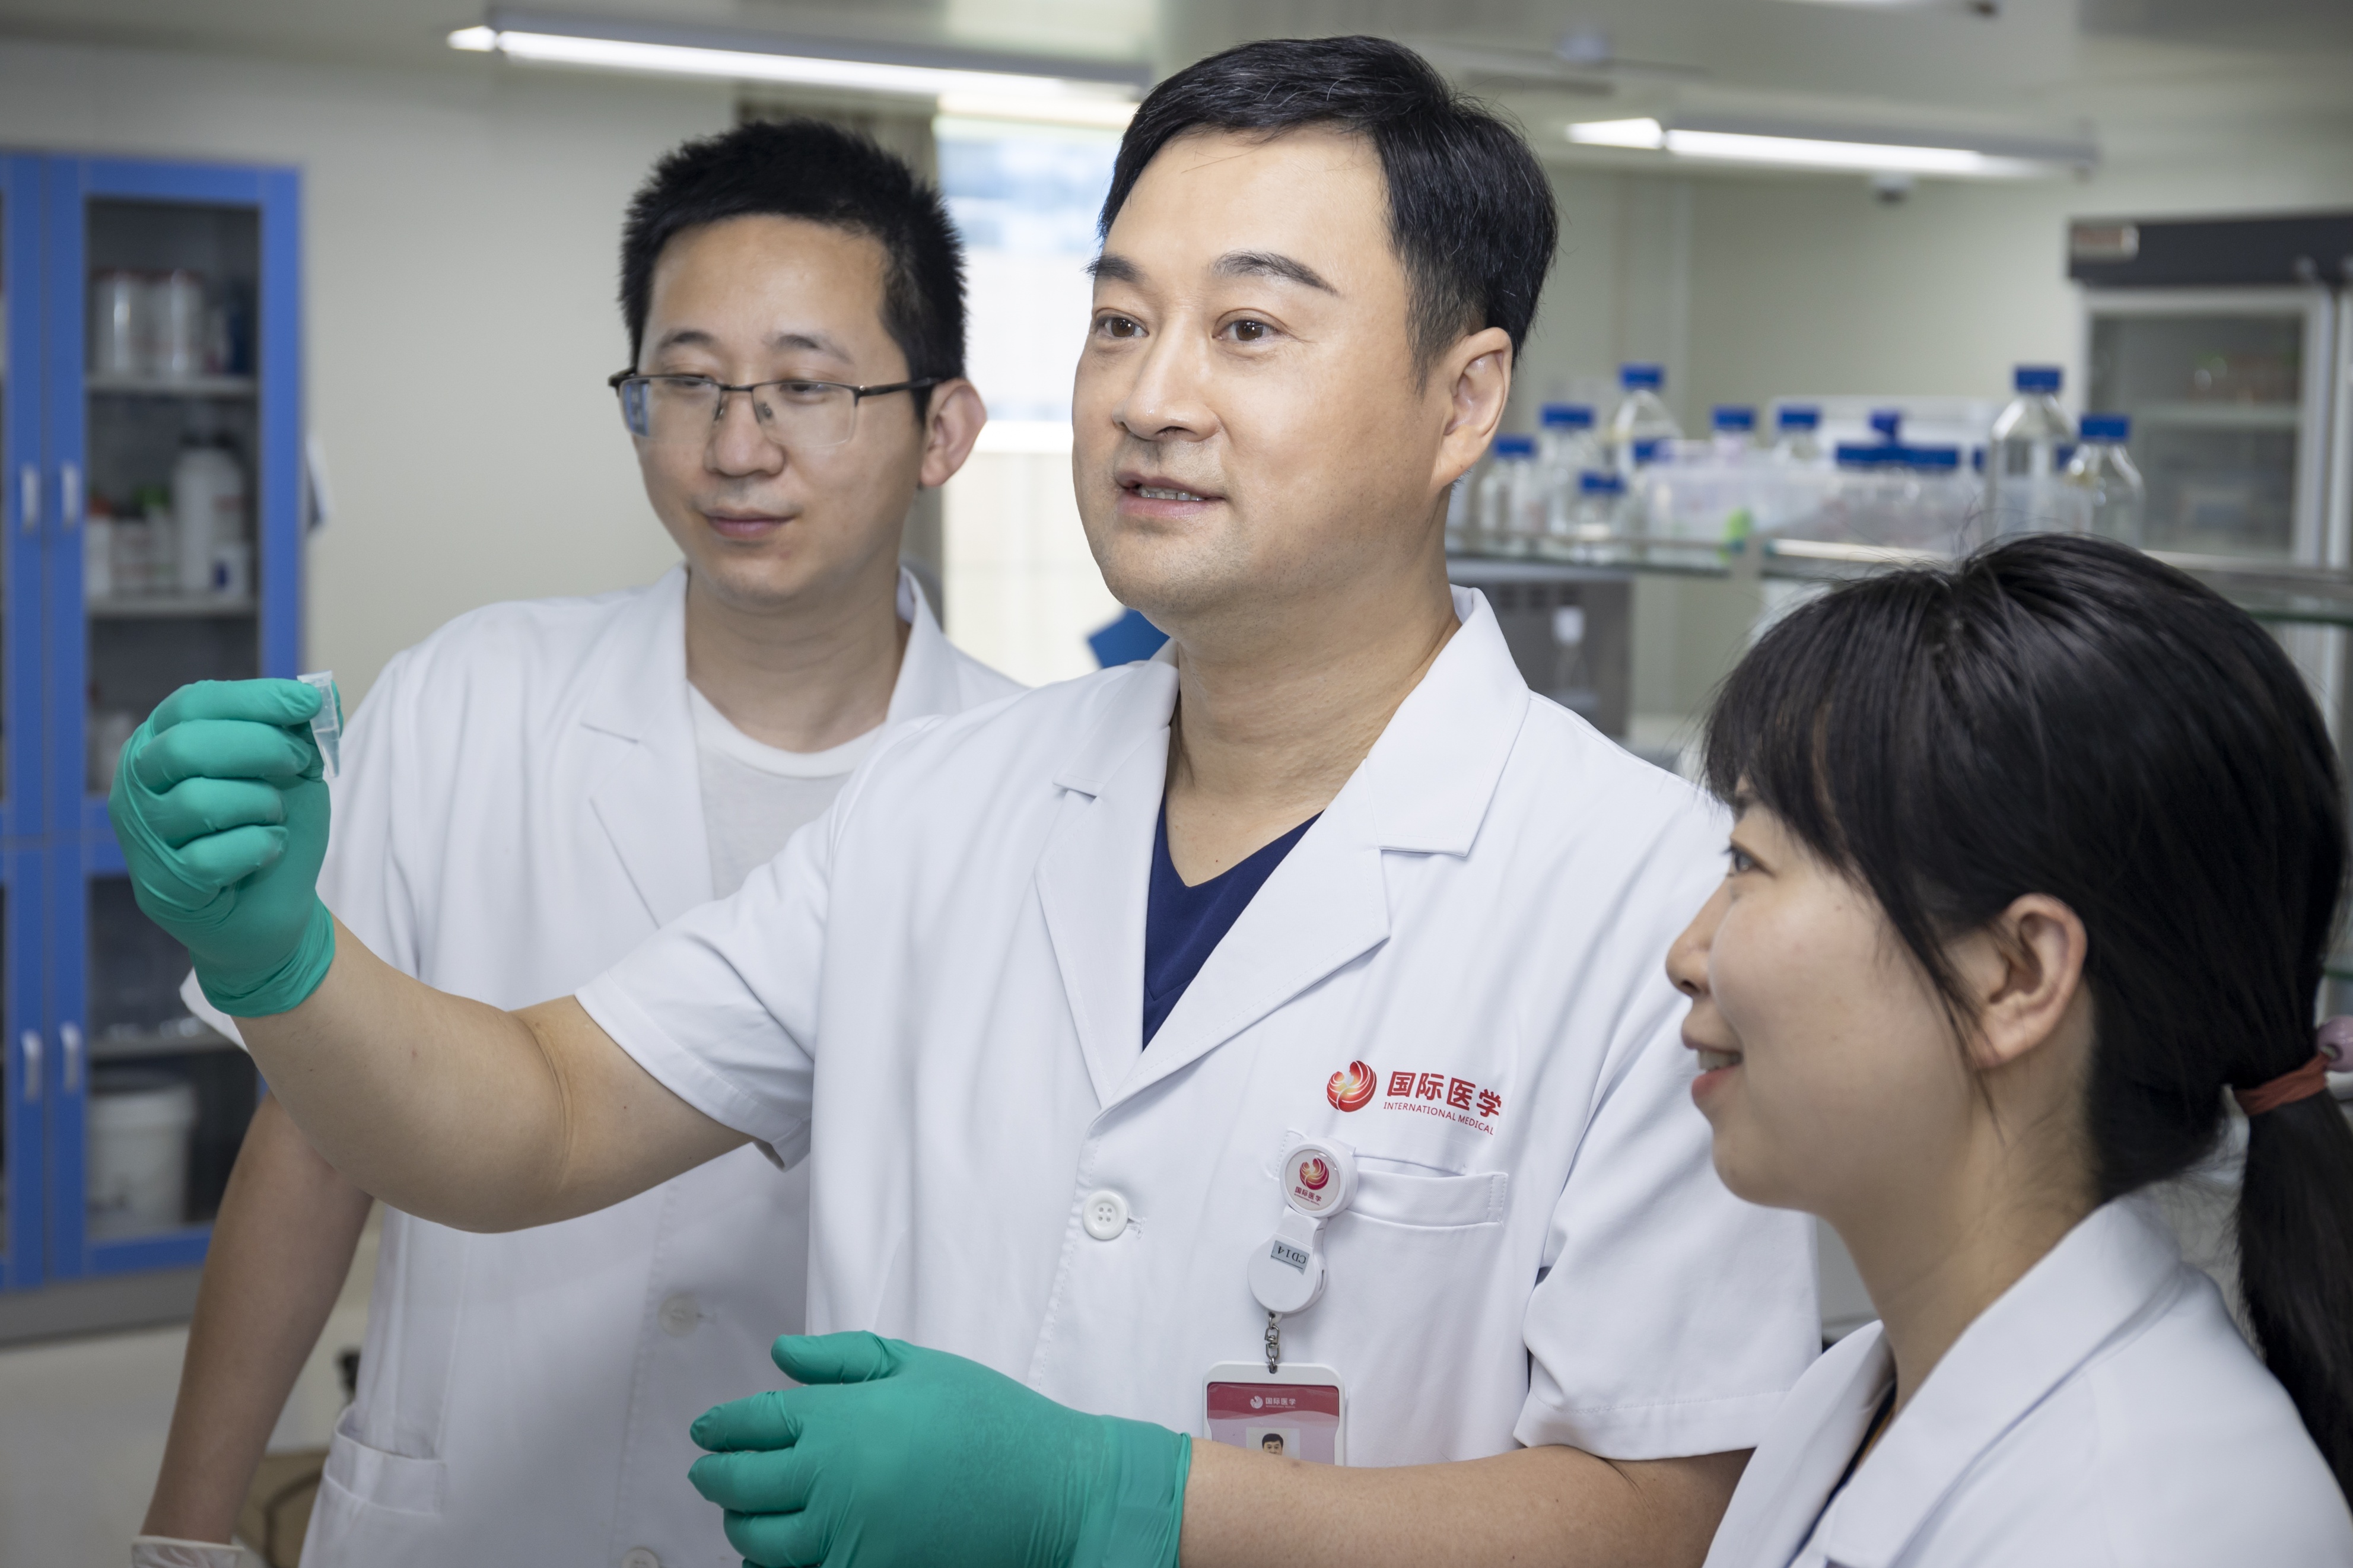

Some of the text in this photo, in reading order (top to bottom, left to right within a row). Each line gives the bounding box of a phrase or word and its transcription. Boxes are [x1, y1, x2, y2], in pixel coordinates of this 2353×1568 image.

[1387, 1071, 1502, 1118] 国际医学
[1384, 1102, 1493, 1135] INTERNATIONAL MEDICAL
[1295, 1186, 1322, 1202] 国际医学
[1277, 1245, 1306, 1264] CD14
[1265, 1397, 1296, 1405] 国际医学
